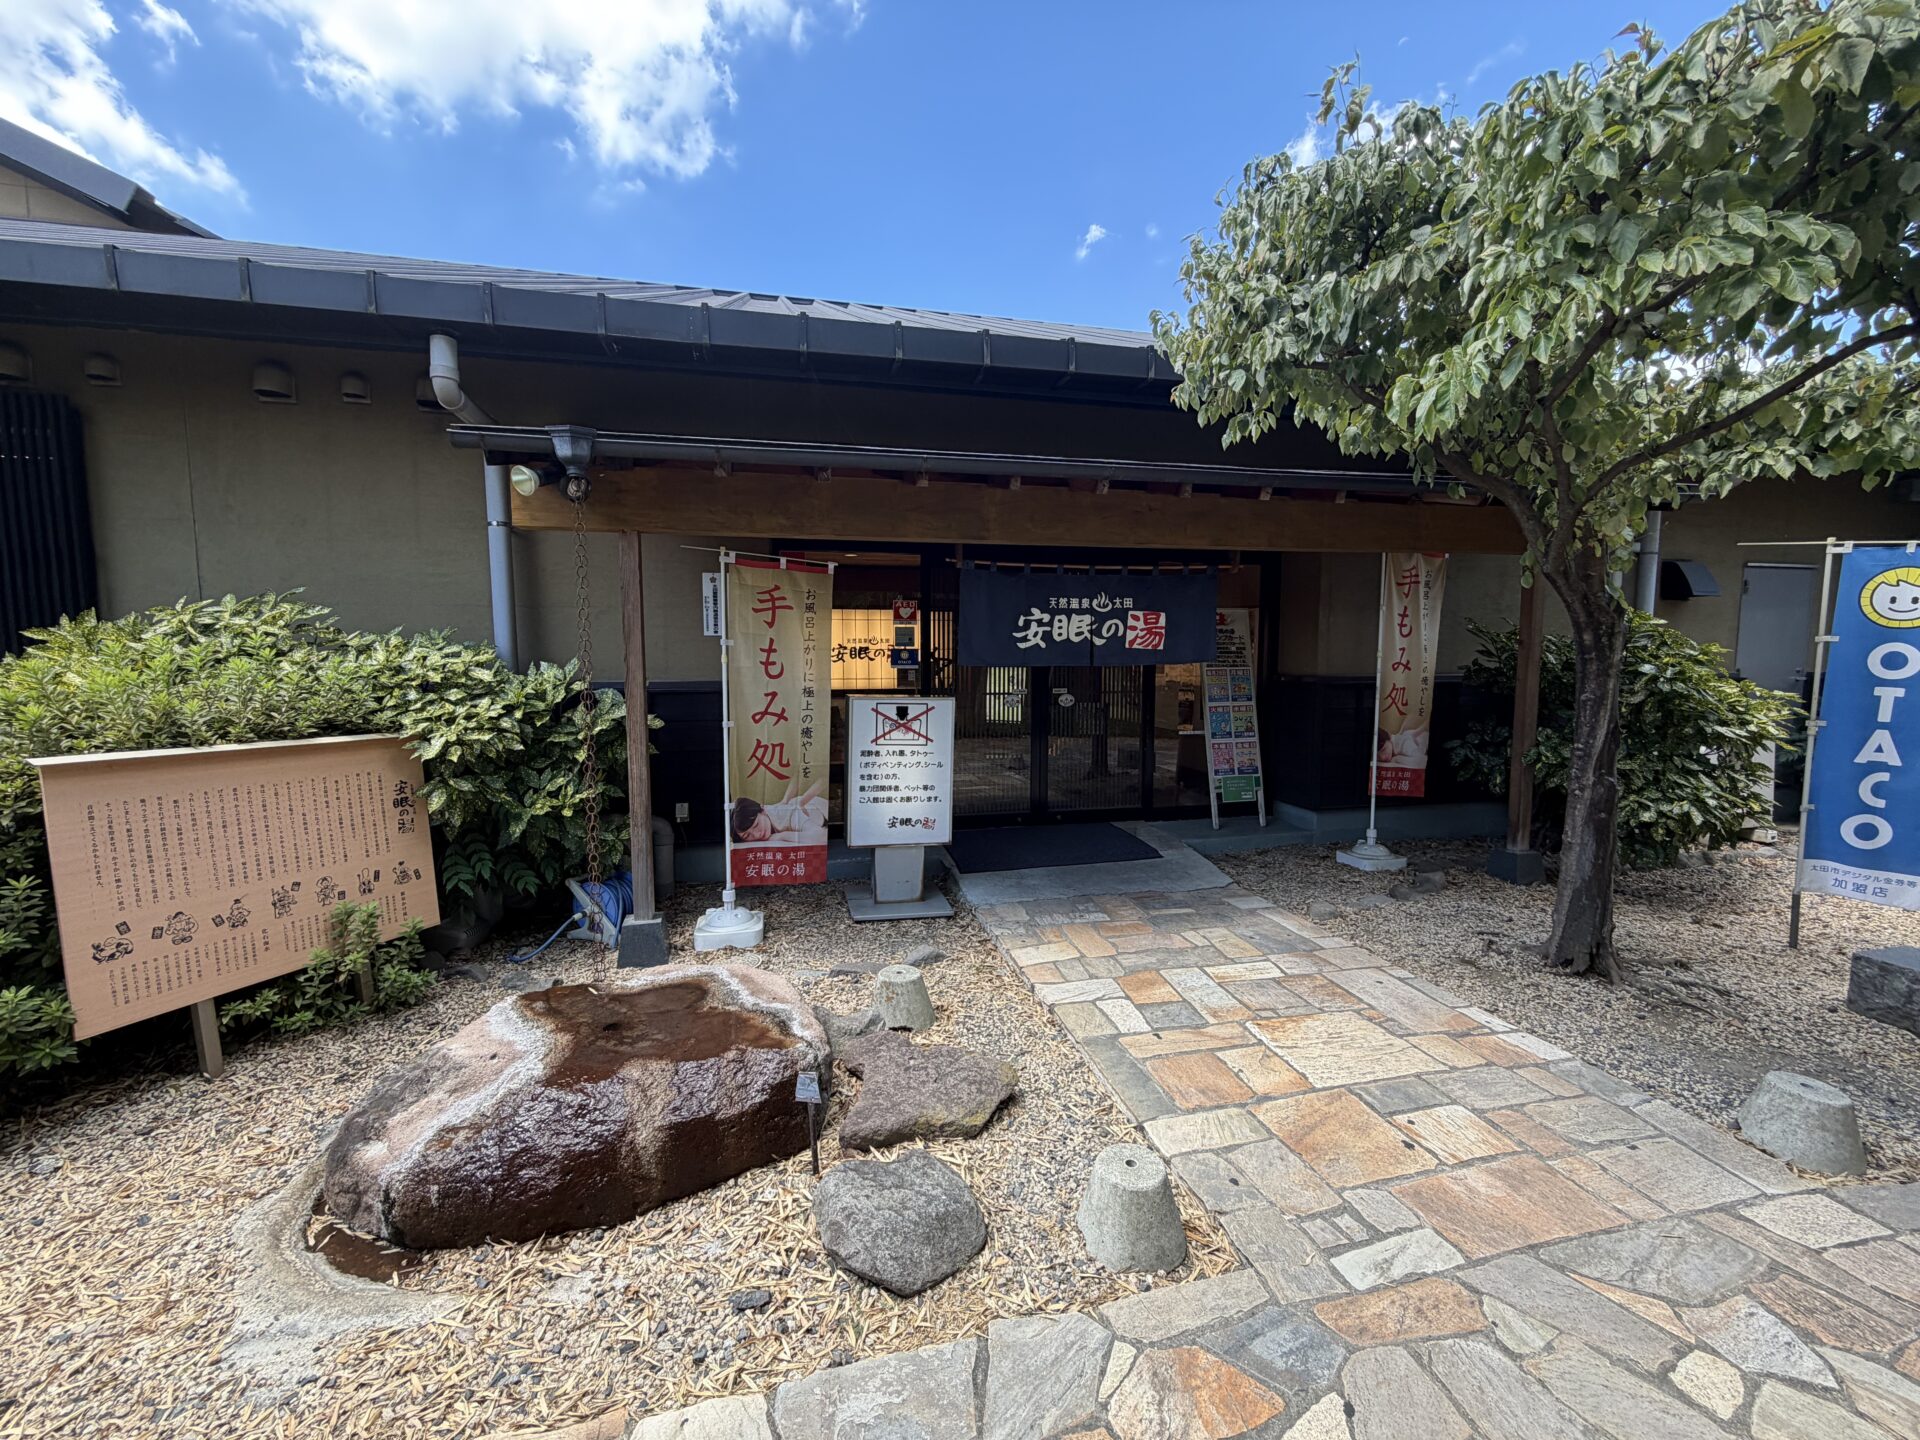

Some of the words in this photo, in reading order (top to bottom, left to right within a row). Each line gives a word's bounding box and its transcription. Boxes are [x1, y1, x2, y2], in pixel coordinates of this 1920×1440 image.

[1049, 597, 1091, 610] 天然温泉
[1113, 597, 1134, 609] 太田
[1012, 608, 1167, 650] 安眠の湯
[1381, 564, 1421, 716] 手もみ処
[831, 643, 895, 663] 安眠の
[746, 583, 795, 781] 手もみ処
[800, 588, 818, 779] お風呂上がりに極上の癒やしを
[1840, 642, 1920, 850] OTACO
[746, 850, 783, 862] 天然温泉
[788, 850, 806, 861] 太田
[745, 862, 806, 878] 安眠の湯
[1810, 863, 1919, 889] 太田市デジタル金券等
[1831, 877, 1889, 898] 加盟店
